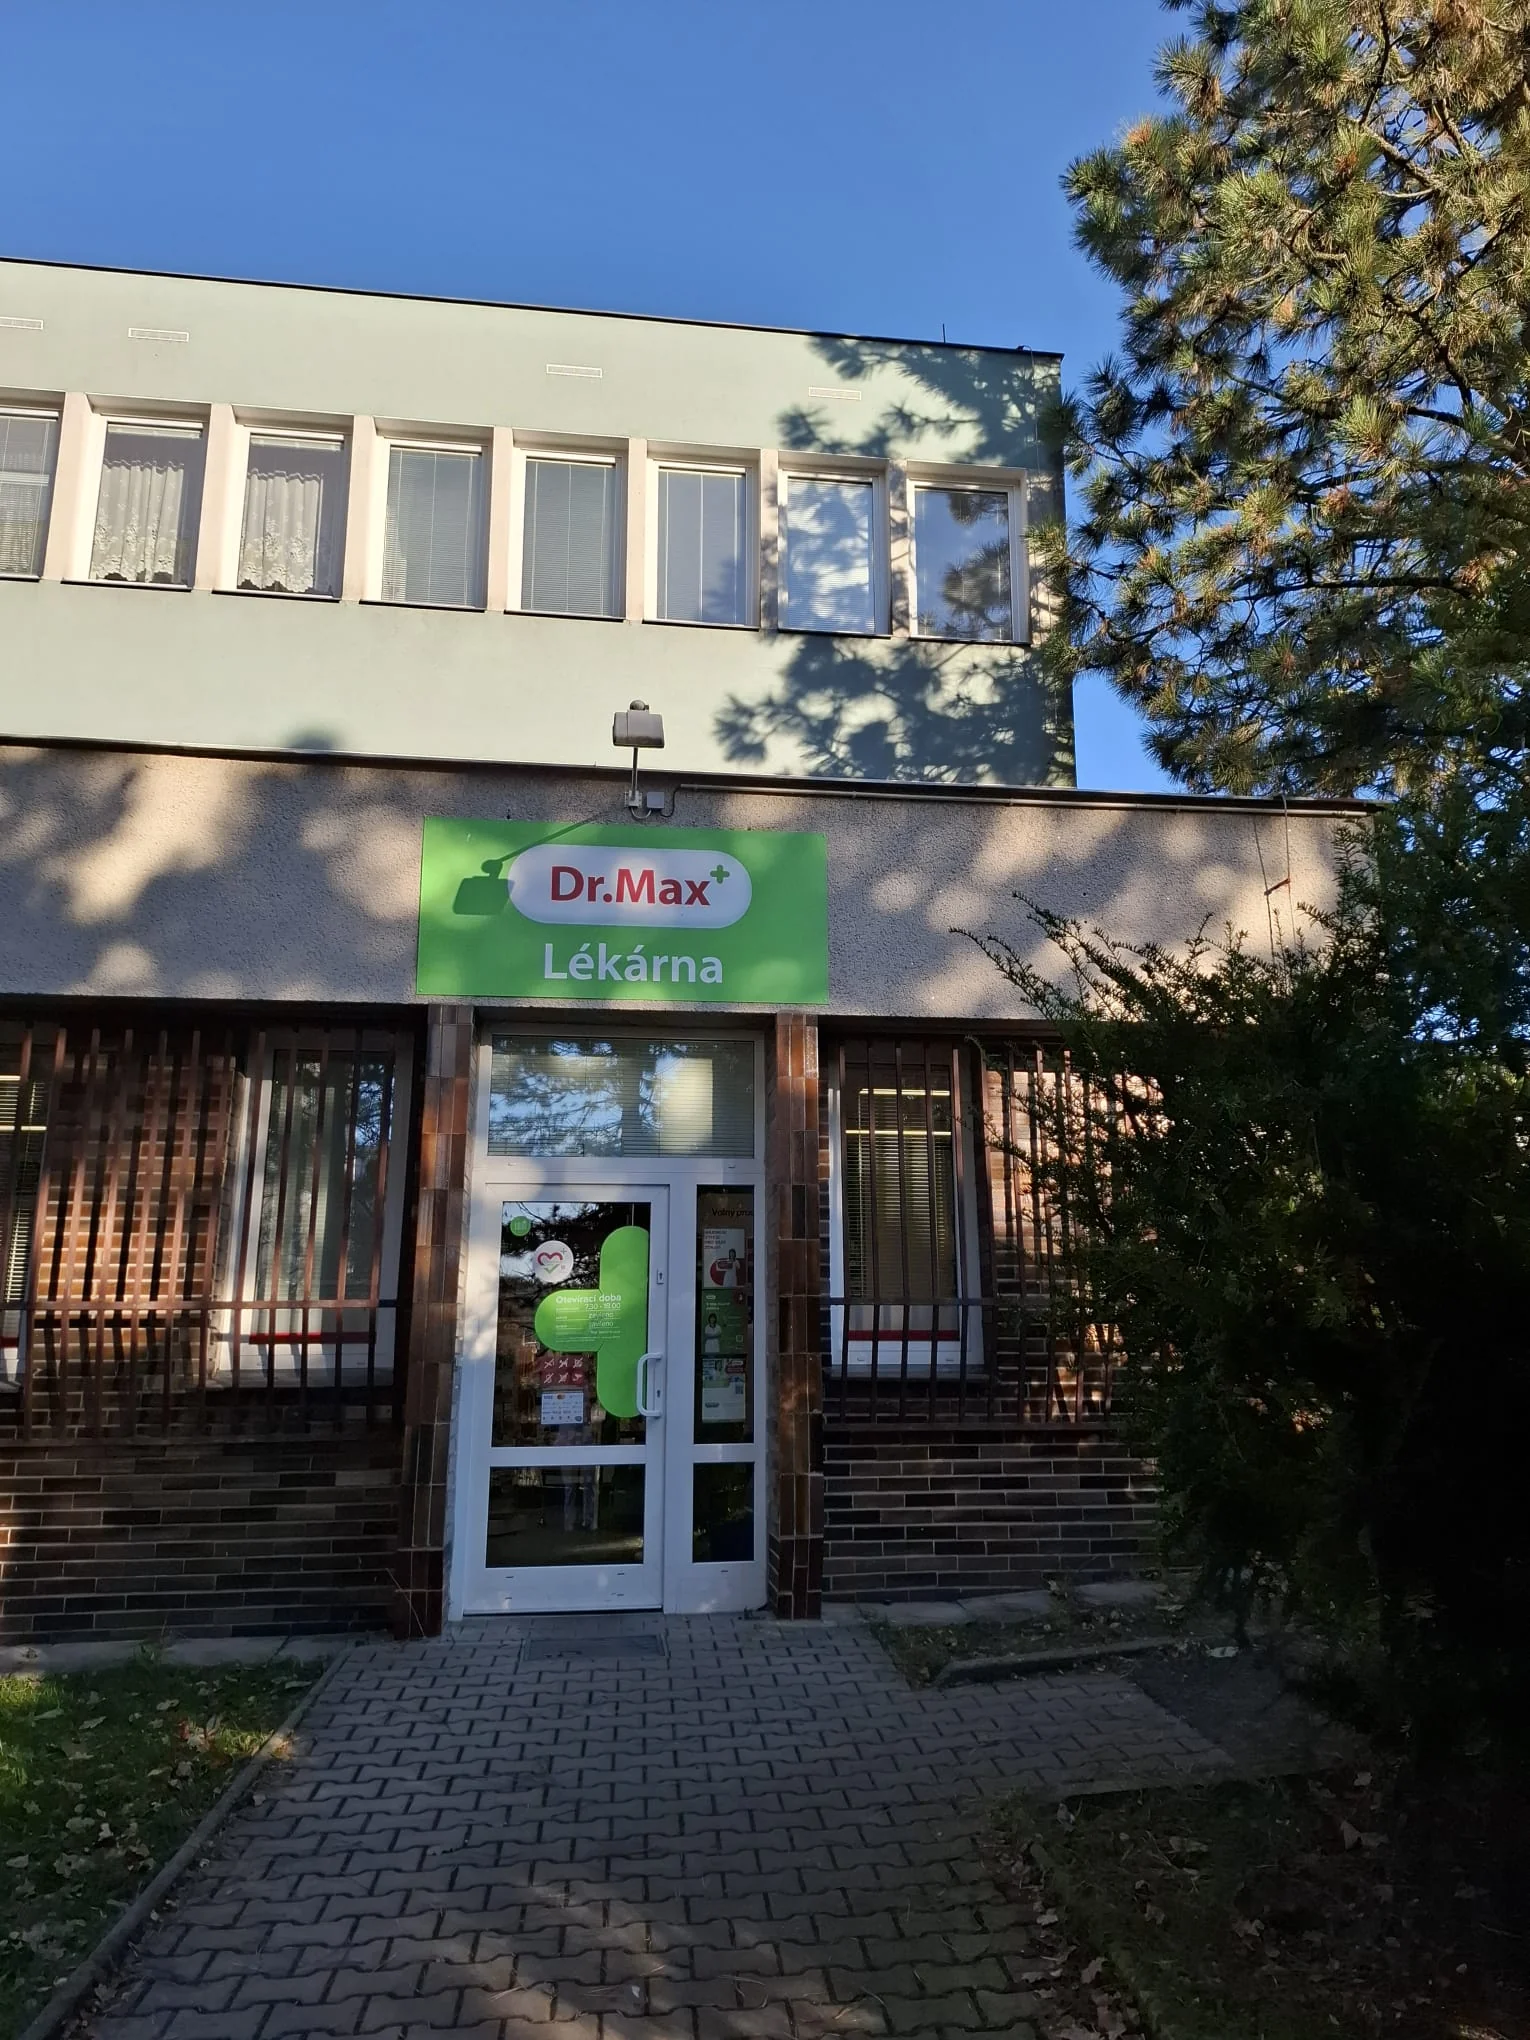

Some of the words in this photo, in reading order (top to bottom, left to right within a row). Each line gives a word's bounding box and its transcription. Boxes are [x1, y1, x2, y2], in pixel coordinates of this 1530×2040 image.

[550, 864, 711, 906] Dr.Max
[543, 942, 724, 985] Lékárna
[556, 1295, 596, 1303] Otevírací
[599, 1294, 622, 1302] doba
